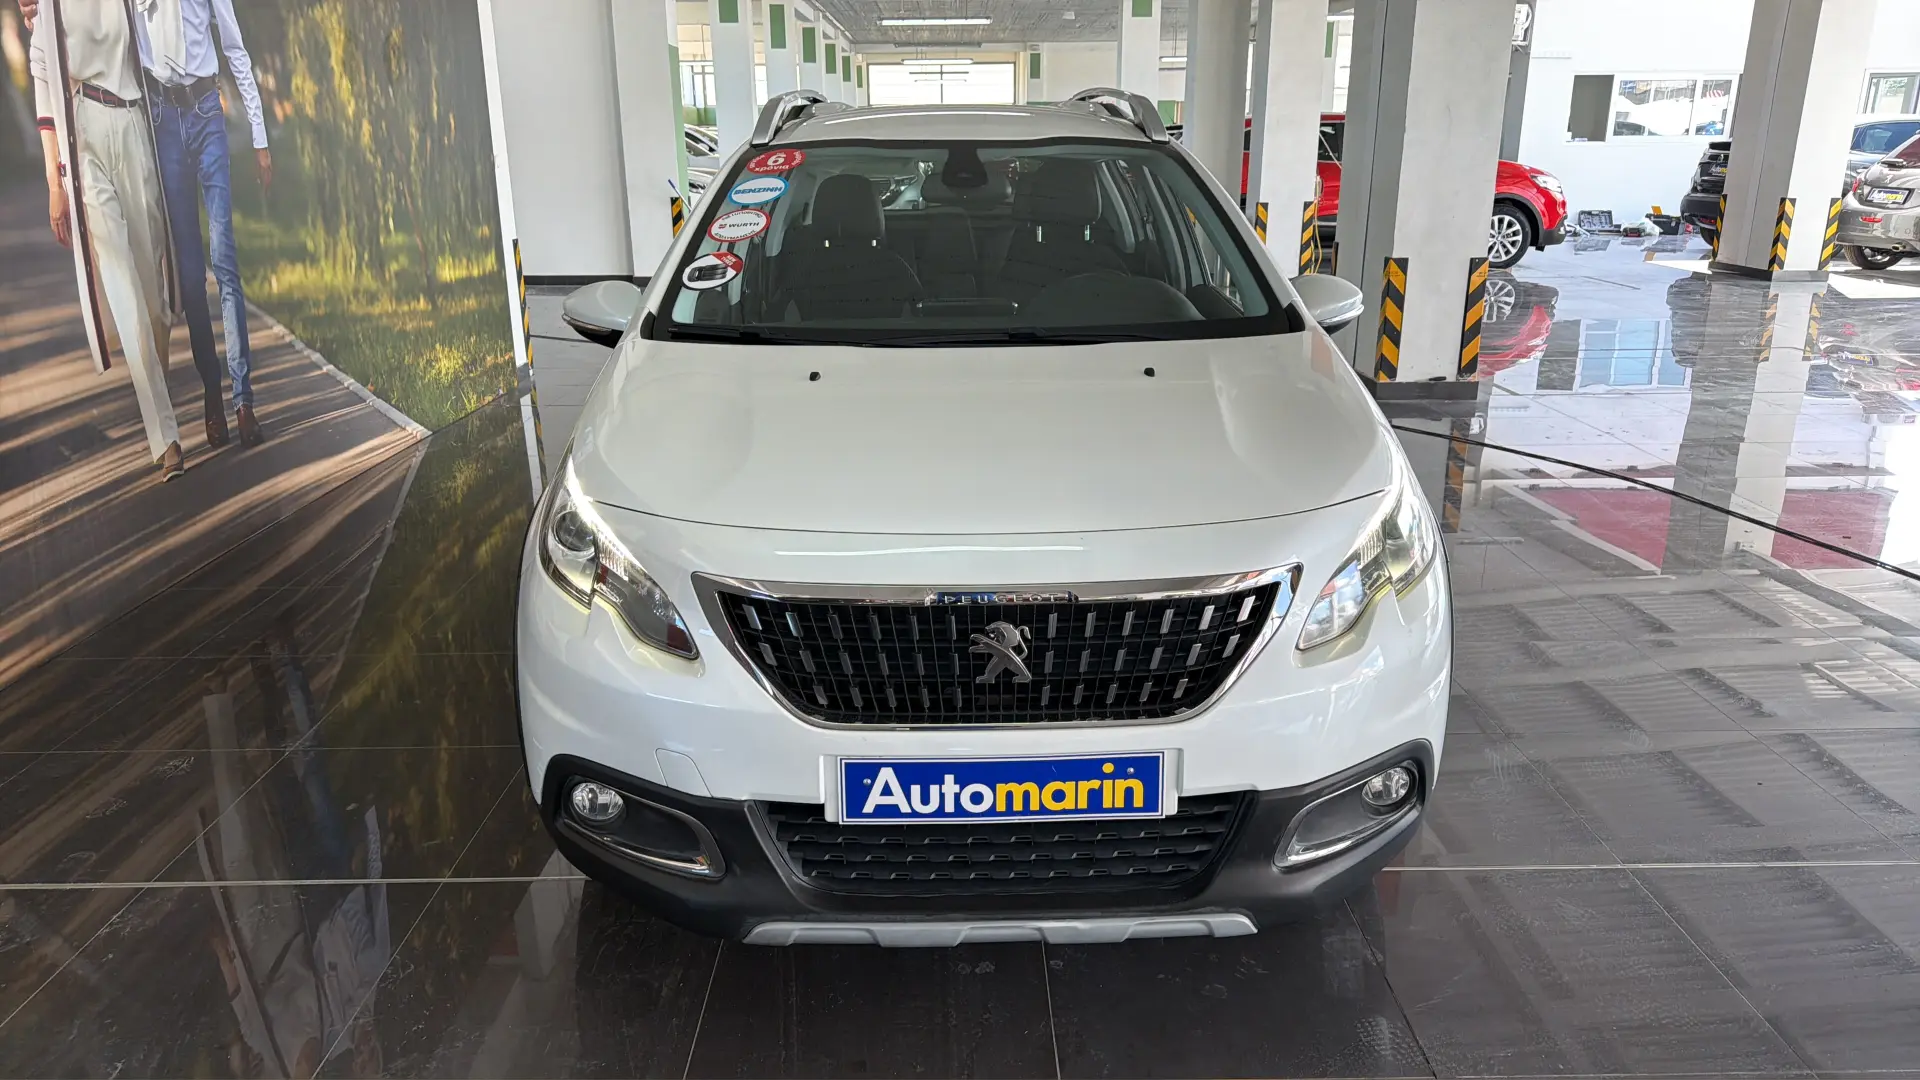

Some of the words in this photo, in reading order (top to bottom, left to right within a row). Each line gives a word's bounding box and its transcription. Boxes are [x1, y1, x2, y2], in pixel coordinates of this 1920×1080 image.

[767, 154, 787, 166] 6
[754, 164, 790, 172] χρόνια
[942, 593, 1058, 604] PEUGEOT
[862, 762, 1143, 813] Automarin
